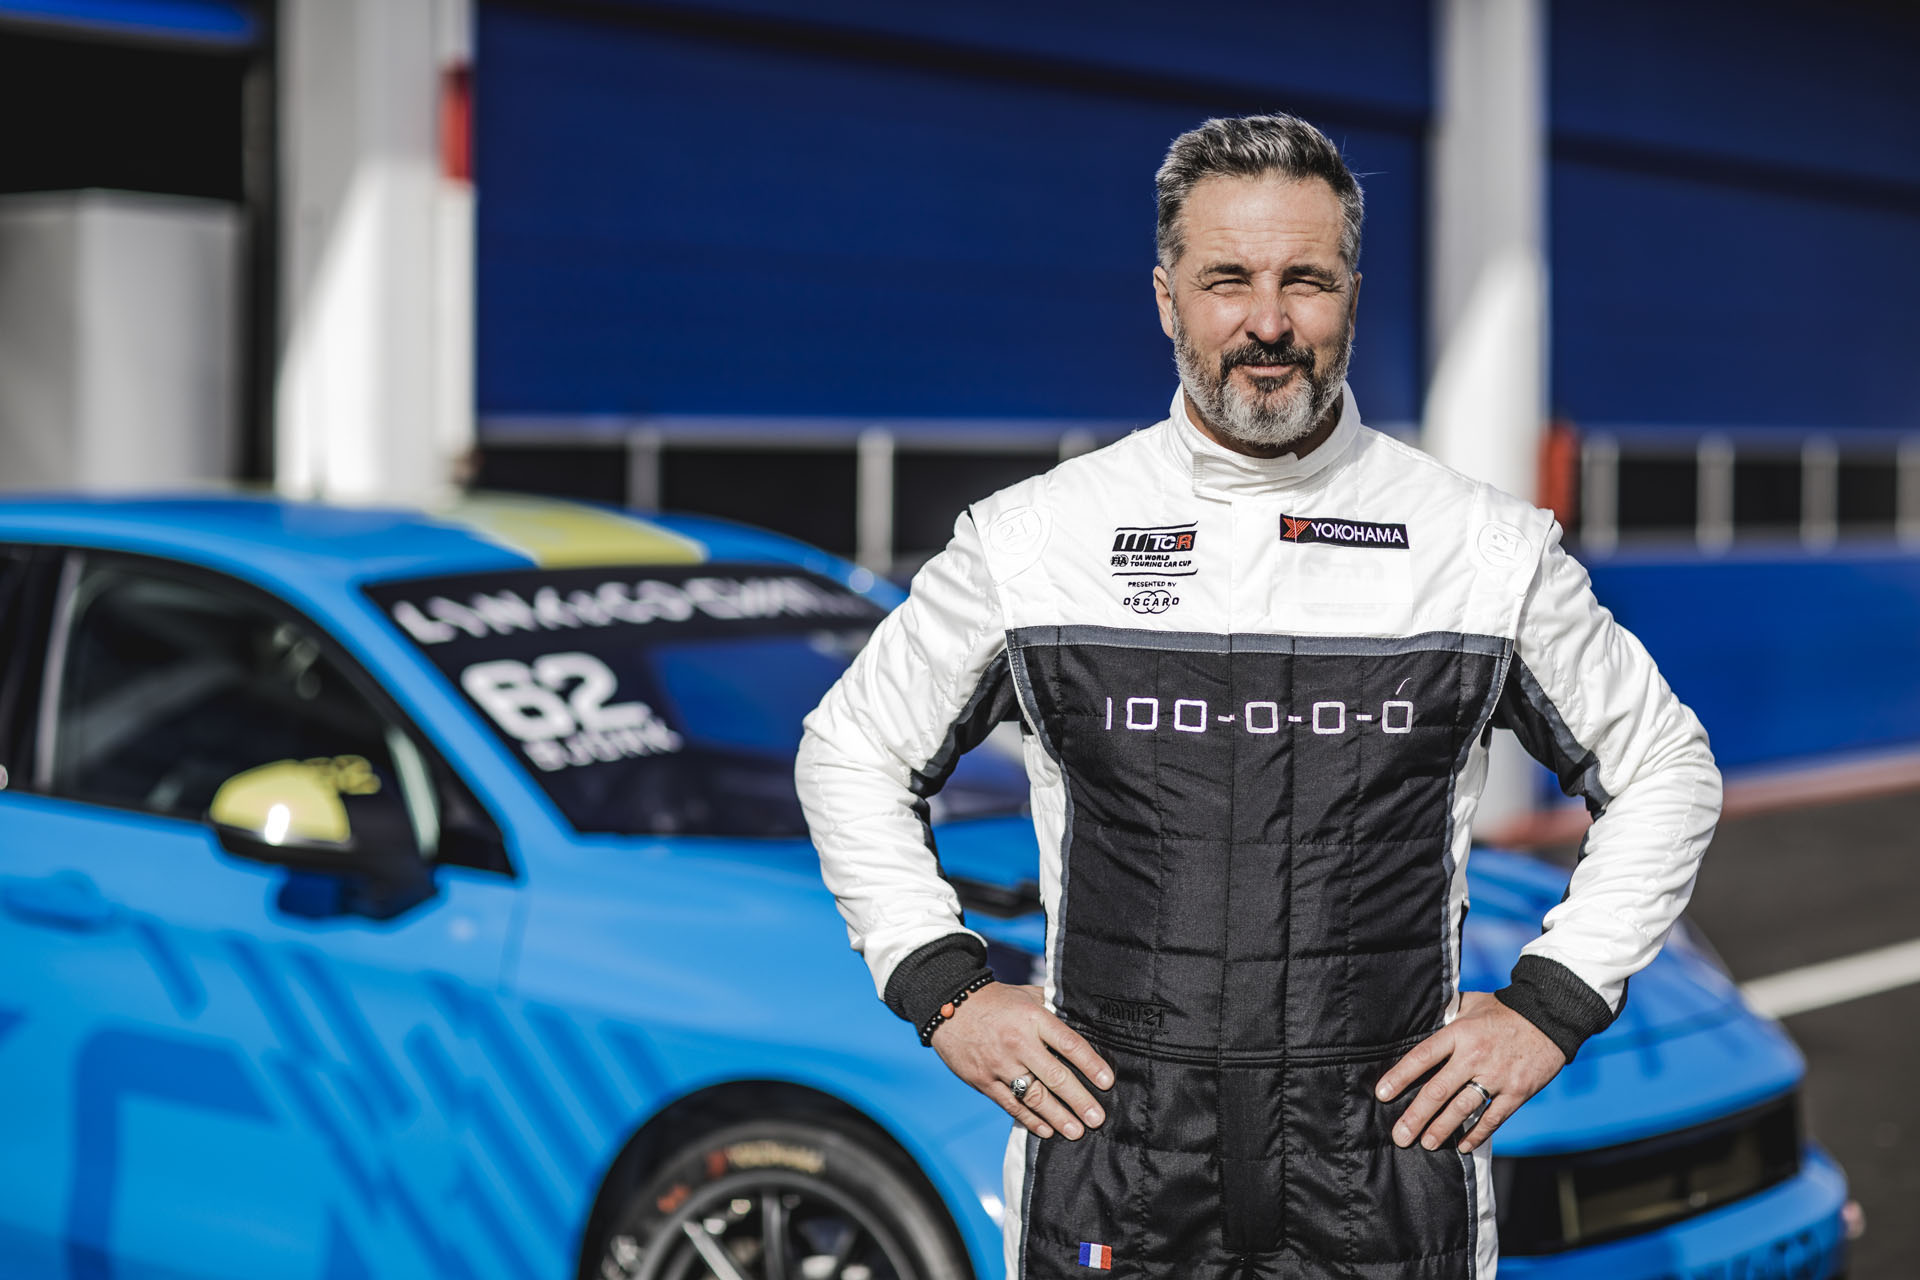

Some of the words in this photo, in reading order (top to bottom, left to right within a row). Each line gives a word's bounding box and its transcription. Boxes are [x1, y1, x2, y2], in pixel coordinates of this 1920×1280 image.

[1311, 522, 1405, 543] YOKOHAMA
[1123, 597, 1180, 606] OSCARO
[461, 651, 653, 742] 62
